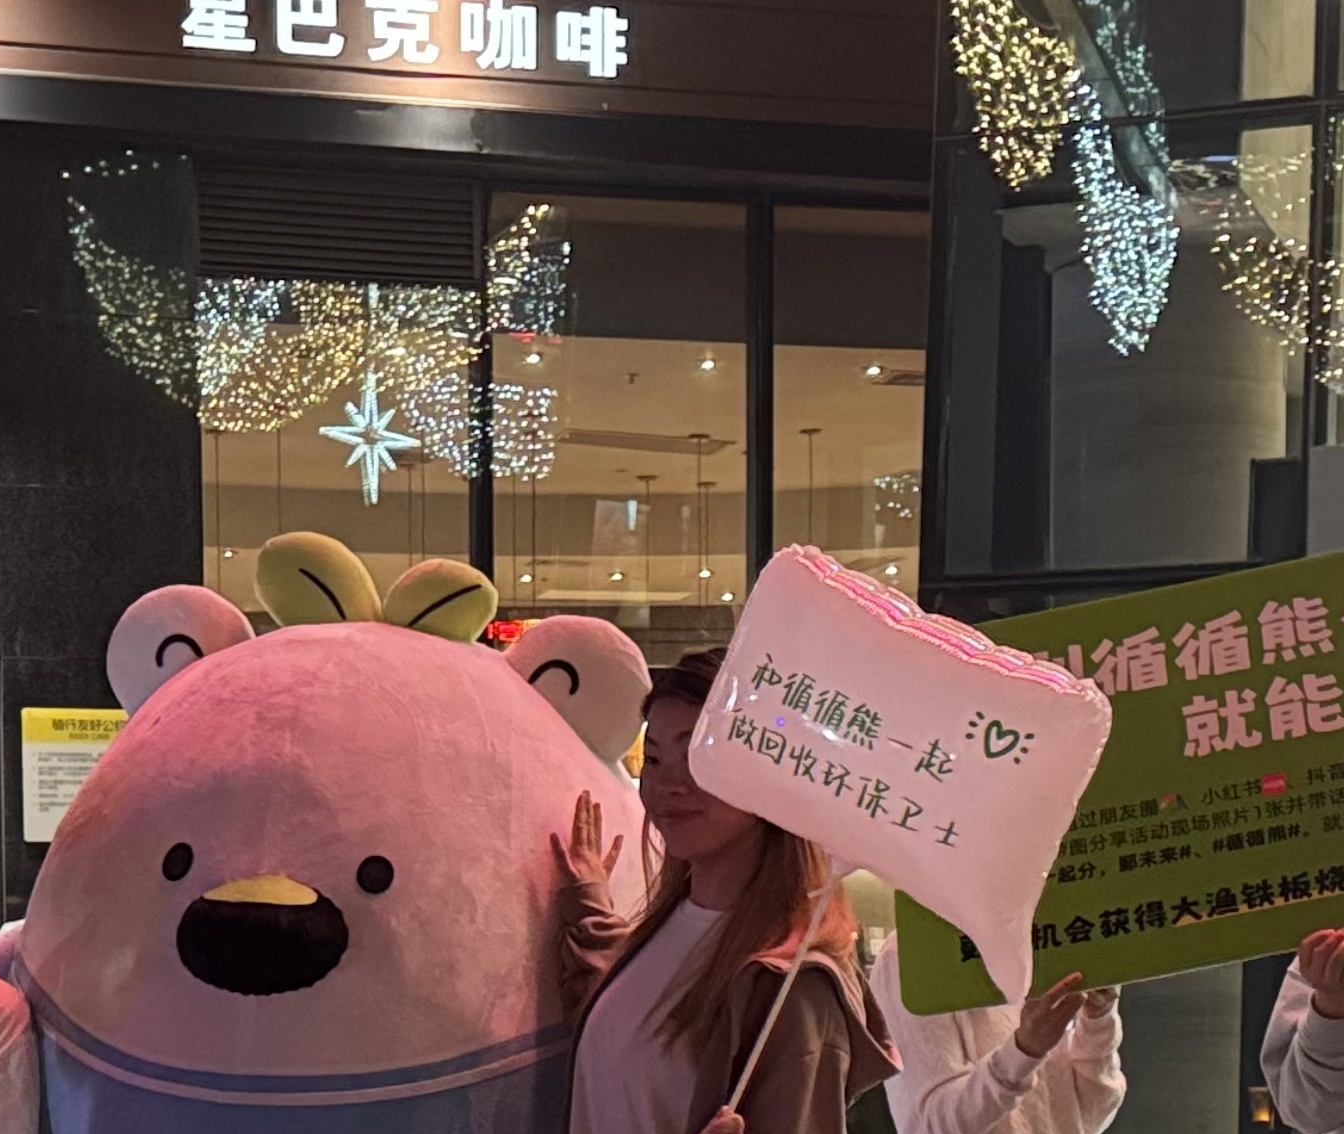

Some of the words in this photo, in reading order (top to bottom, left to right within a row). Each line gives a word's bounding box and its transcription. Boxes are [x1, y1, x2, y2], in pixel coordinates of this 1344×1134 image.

[181, 0, 629, 78] 星巴克咖啡
[727, 708, 959, 848] 做回收环保卫士
[751, 653, 957, 782] 和循循熊一起
